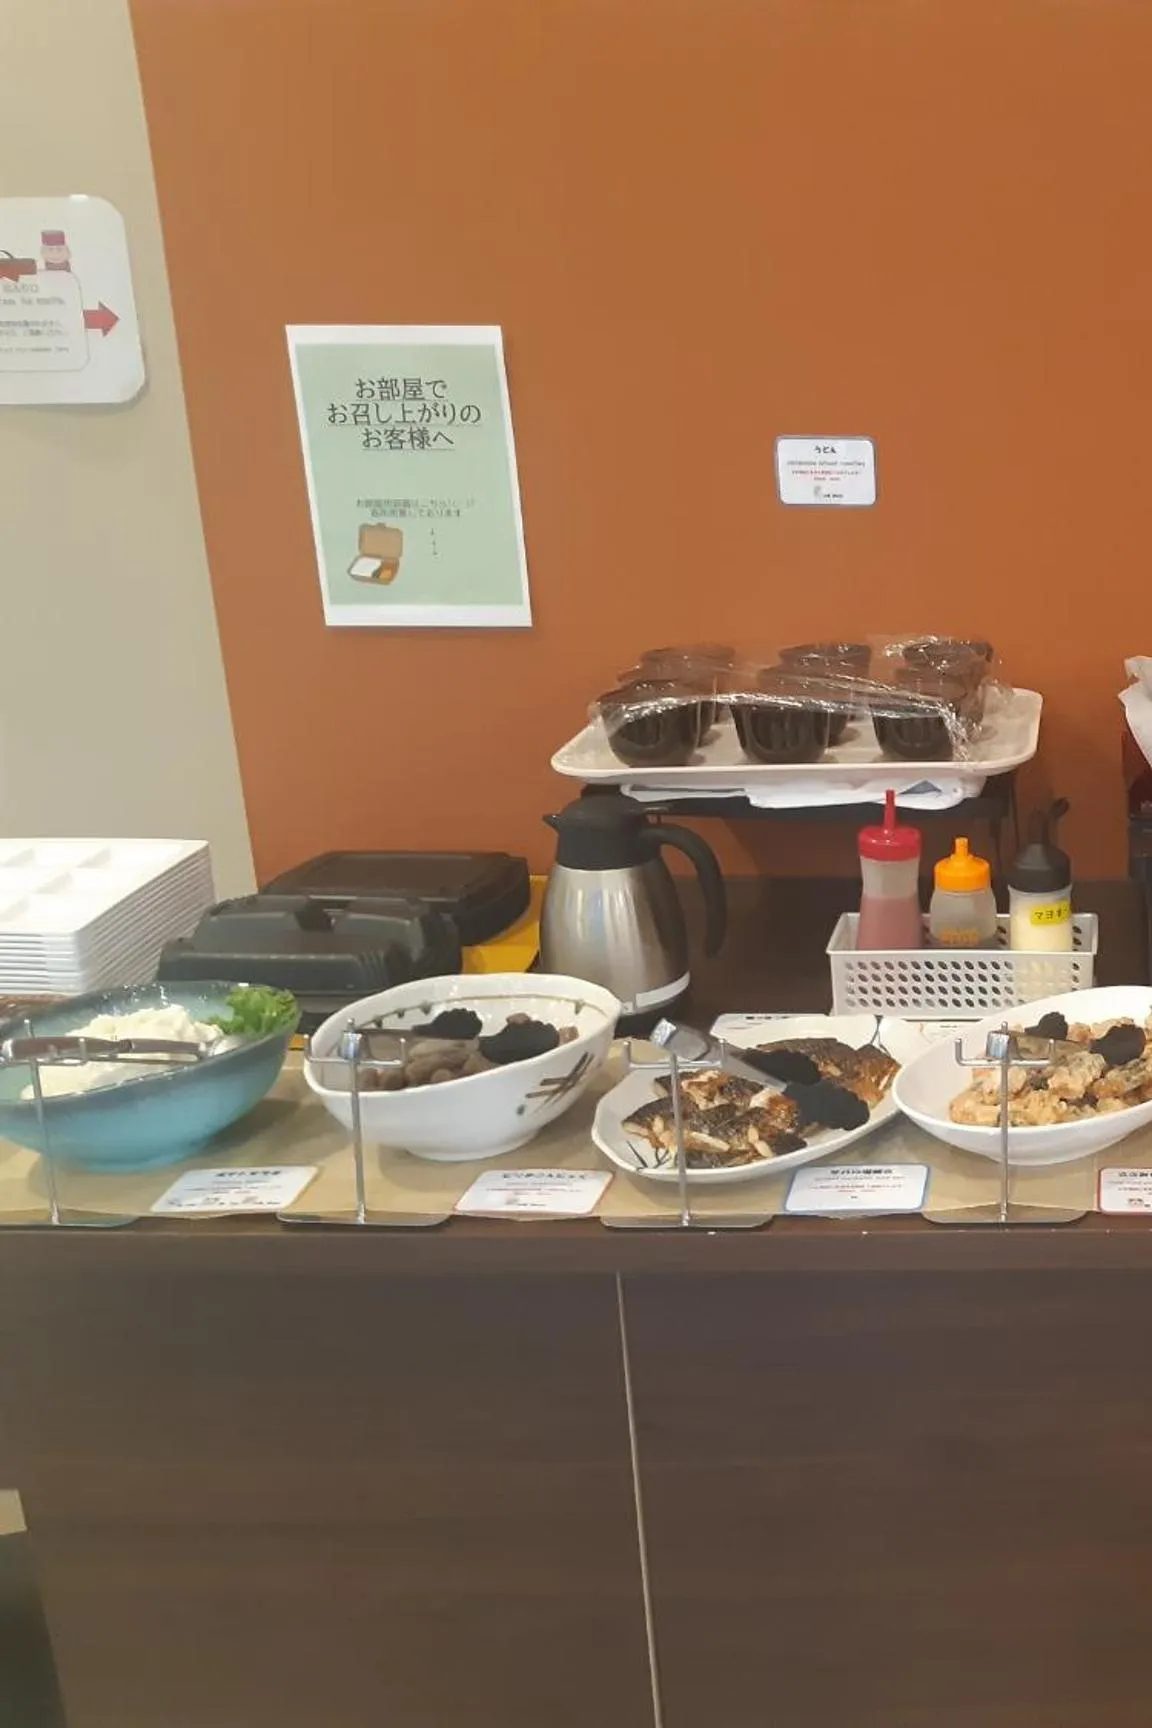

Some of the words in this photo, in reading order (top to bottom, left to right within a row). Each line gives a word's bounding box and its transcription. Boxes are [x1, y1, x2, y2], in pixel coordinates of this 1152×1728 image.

[356, 377, 448, 400] お部屋で
[327, 403, 482, 425] お召し上がりの
[362, 427, 455, 450] お客様へ
